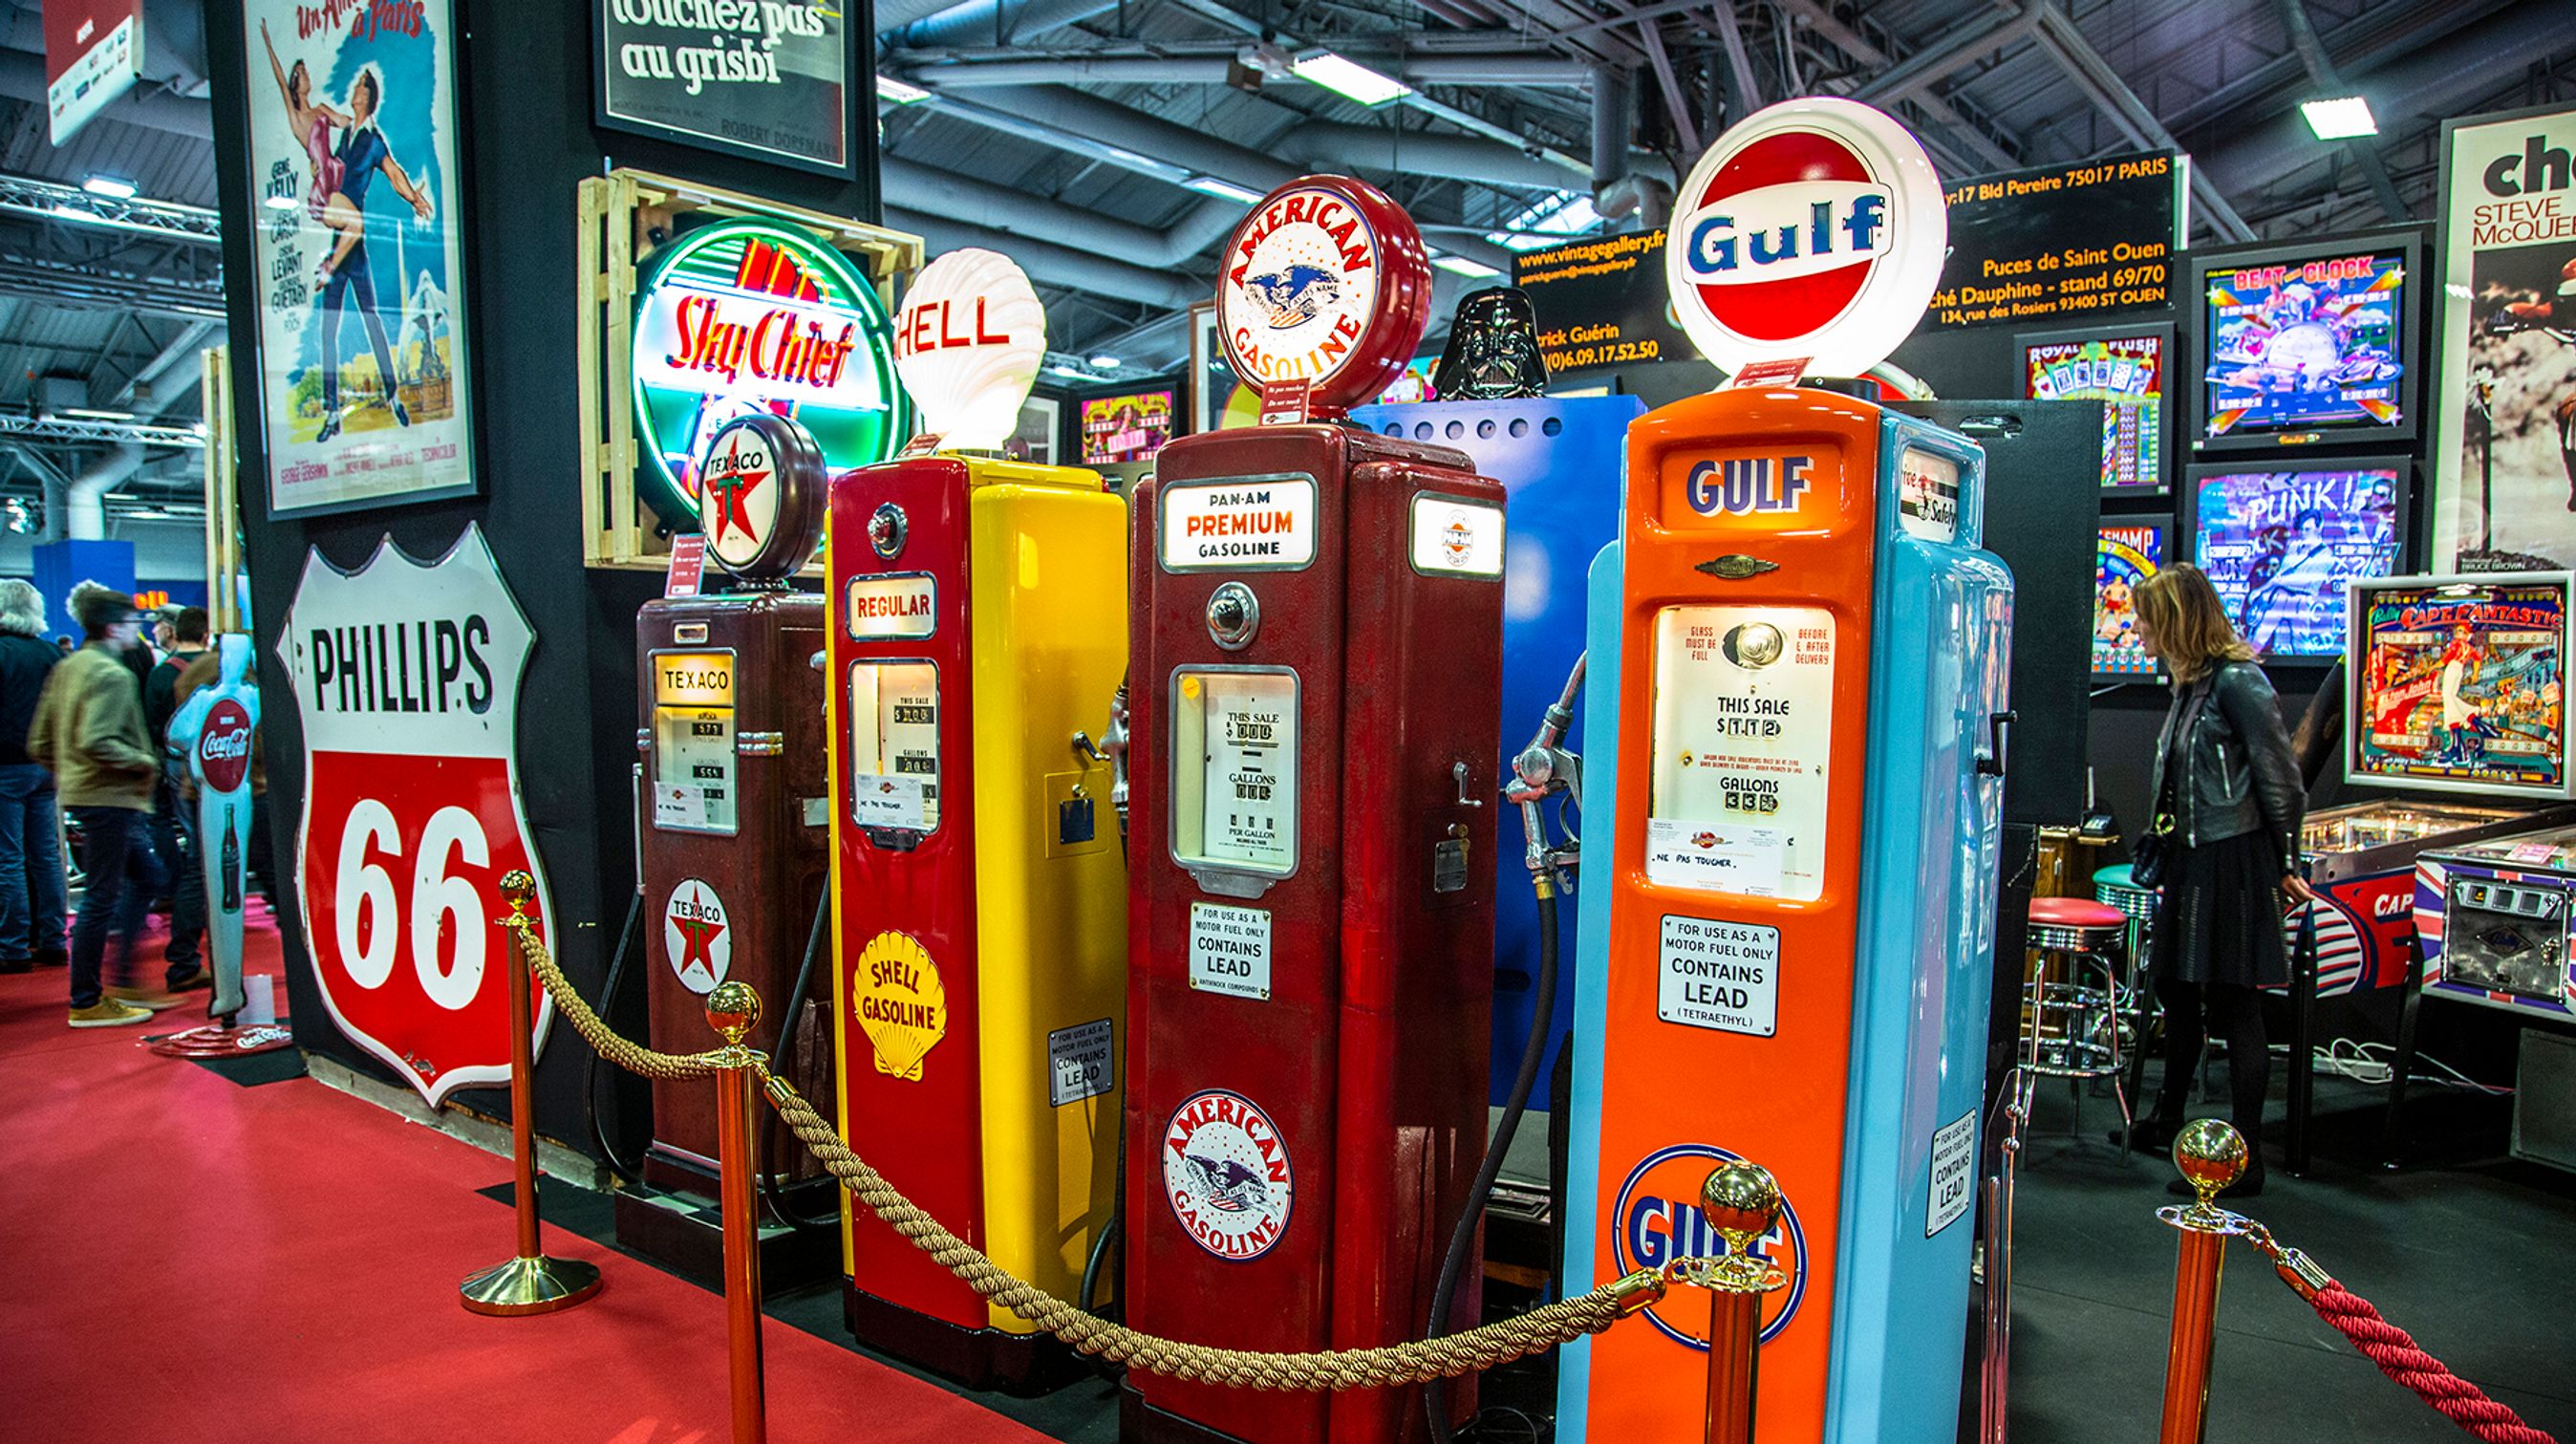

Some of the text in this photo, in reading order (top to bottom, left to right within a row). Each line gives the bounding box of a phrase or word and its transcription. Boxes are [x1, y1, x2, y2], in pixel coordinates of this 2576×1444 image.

[368, 0, 424, 43] Paris
[612, 0, 826, 45] touchez pas
[621, 35, 781, 96] au grisbi
[1979, 182, 2004, 201] Bld
[2007, 177, 2062, 197] Pereire
[2066, 165, 2114, 186] 75017
[2119, 158, 2168, 180] PARIS
[2483, 135, 2576, 197] ch
[2473, 196, 2562, 226] STEVE
[1230, 196, 1372, 290] AMERICAN
[1687, 193, 1886, 274] Gulf
[1519, 229, 1666, 268] www.vintagegallery.fr
[1984, 242, 2165, 277] Puces de Saint Ouen
[2234, 255, 2375, 291] BEAT CLOCK
[1929, 289, 1958, 309] ché
[1962, 282, 2042, 305] Dauphine
[2060, 271, 2108, 294] stand
[2113, 265, 2165, 287] 69/70
[1965, 308, 1986, 321] rue
[1988, 302, 2010, 318] des
[2011, 298, 2057, 315] Rosiers
[2059, 293, 2098, 311] 93400
[2100, 291, 2117, 307] ST
[2120, 288, 2165, 304] OUEN
[894, 295, 1011, 360] HELL
[1537, 323, 1620, 348] trick Guérin
[666, 295, 858, 388] Sky Chief
[1235, 313, 1361, 379] GASOLINE
[2109, 337, 2157, 354] FLUSH
[710, 451, 763, 475] TEXACO
[1686, 456, 1814, 518] GULF
[2248, 474, 2353, 531] PUNK!
[1187, 510, 1293, 537] PREMIUM
[1198, 542, 1280, 558] GASOLINE
[2104, 528, 2154, 558] CHAMP
[858, 594, 930, 617] REGULAR
[2456, 604, 2565, 626] FANTASTIC
[1685, 638, 1717, 650] MUST BE
[1690, 626, 1713, 636] GLASS
[1798, 629, 1827, 639] BEFORE
[1692, 651, 1708, 661] FULL
[1795, 654, 1830, 665] DELIVERY
[1806, 642, 1830, 652] AFTER
[311, 614, 494, 716] PHILLIPS
[665, 671, 728, 690] TEXACO
[1228, 712, 1279, 724] THIS SALE
[1717, 697, 1790, 715] THIS SALE
[1229, 773, 1277, 786] GALLONS
[1720, 776, 1779, 793] GALLONS
[1229, 828, 1277, 839] PER GALLON
[1676, 853, 1691, 864] PAS
[335, 798, 490, 1011] 66
[674, 900, 720, 922] TEXACO
[1204, 909, 1256, 923] FOR USE AS A
[1195, 921, 1265, 938] MOTOR FUEL ONLY
[1678, 923, 1761, 943] FOR USE AS A
[1197, 937, 1262, 958] CONTAINS
[1665, 938, 1773, 960] MOTOR FUEL ONLY
[870, 959, 920, 995] SHELL
[1207, 956, 1251, 977] LEAD
[1672, 957, 1764, 984] CONTAINS
[1685, 981, 1748, 1009] LEAD
[863, 997, 935, 1030] GASOLINE
[1052, 1043, 1075, 1054] MOTOR
[1077, 1039, 1093, 1049] FUEL
[1056, 1048, 1106, 1070] CONTAINS
[1065, 1066, 1100, 1087] LEAD
[1169, 1099, 1287, 1183] AMERICAN
[1936, 1150, 1970, 1185] CONTAINS
[1940, 1175, 1964, 1208] LEAD
[1174, 1190, 1279, 1255] GASOLINE
